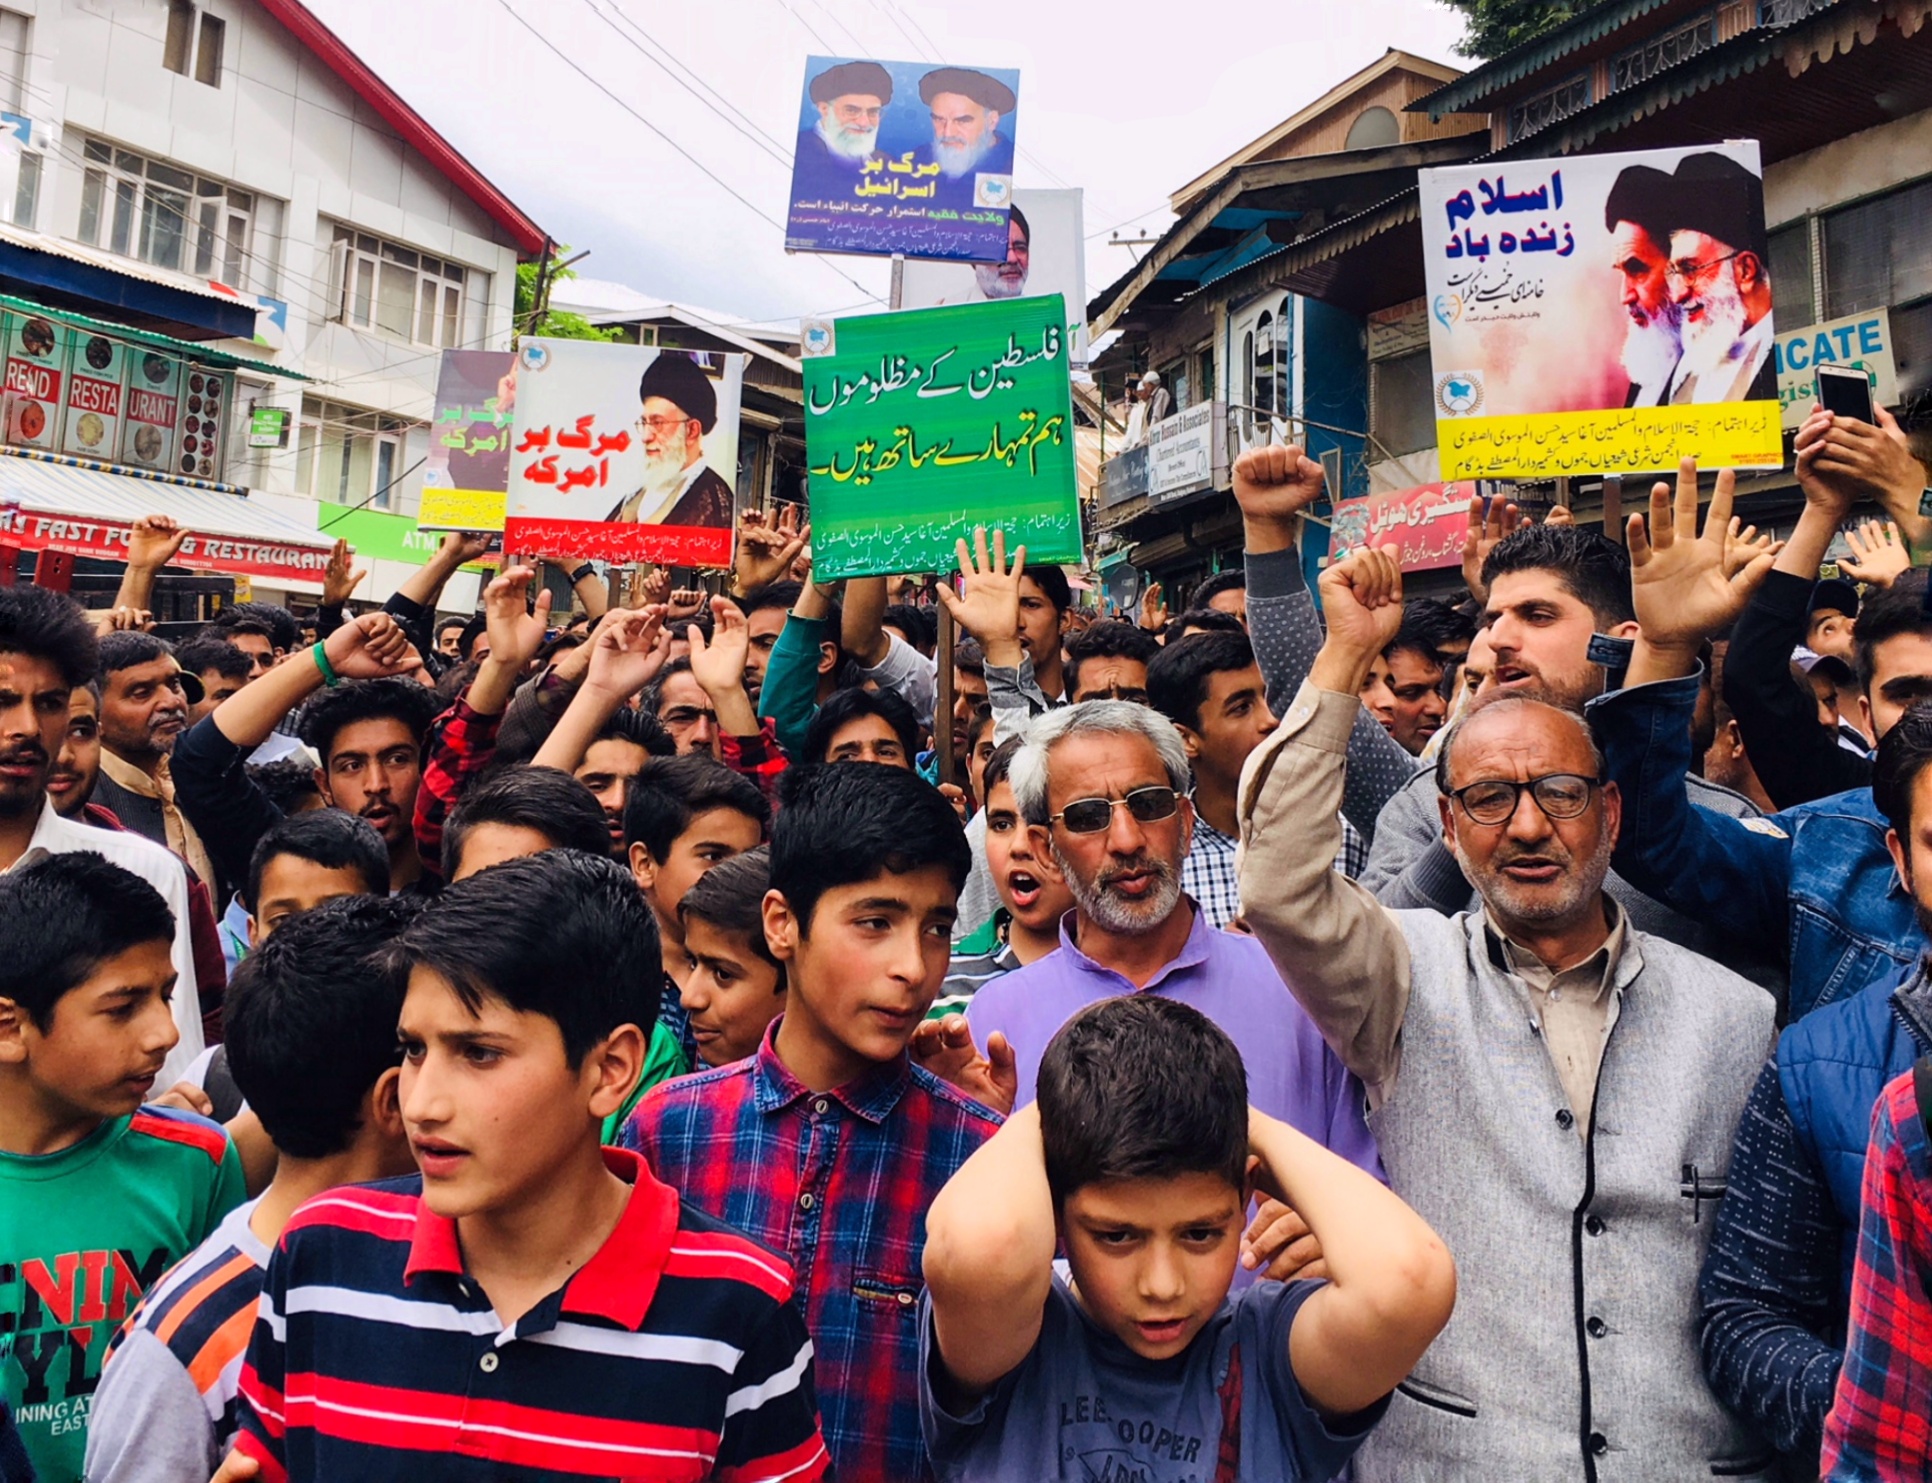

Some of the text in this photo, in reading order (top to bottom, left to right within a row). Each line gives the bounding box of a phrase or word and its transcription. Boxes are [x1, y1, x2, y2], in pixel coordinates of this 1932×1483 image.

[859, 152, 941, 178] مرگ بر
[1446, 169, 1563, 232] اسلام
[1445, 227, 1490, 263] باد
[808, 327, 1061, 415] فلسطین کے مظلوموں
[69, 378, 117, 415] RESTA
[130, 391, 176, 425] URANT
[515, 414, 632, 457] مرگ بر
[873, 426, 937, 472] ساتھ
[934, 411, 1036, 468] تمہارے
[1029, 416, 1062, 477] ہم
[1535, 424, 1560, 444] حسن
[34, 517, 99, 543] FAST
[179, 537, 197, 555] &
[402, 530, 436, 551] ATM
[884, 523, 904, 545] حسن
[1060, 1396, 1107, 1427] LEE
[1118, 1418, 1202, 1463] OOPER
